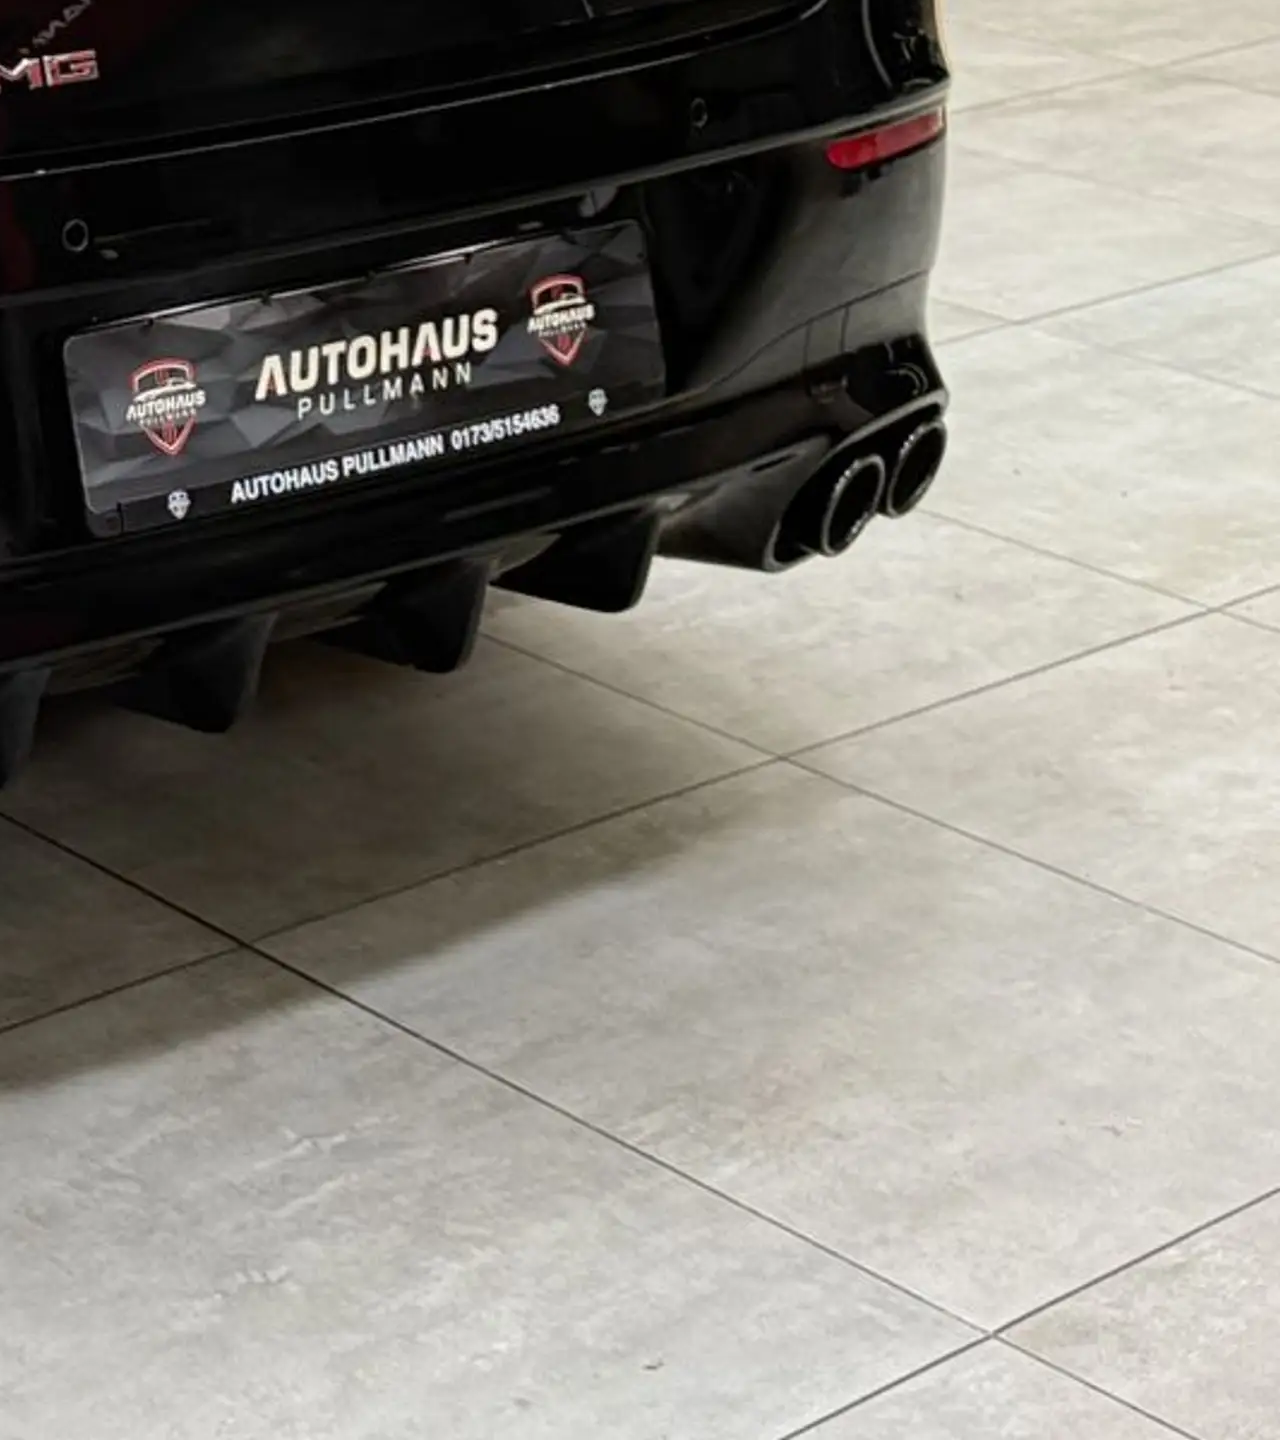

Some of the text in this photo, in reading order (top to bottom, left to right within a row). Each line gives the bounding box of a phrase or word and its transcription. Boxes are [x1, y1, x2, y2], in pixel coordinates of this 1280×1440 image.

[255, 308, 498, 400] AUTOHAUS
[126, 389, 206, 421] AUTOHAUS
[297, 362, 473, 420] PULLMANN
[231, 462, 339, 504] AUTOHAUS
[343, 436, 443, 478] PULLMANN
